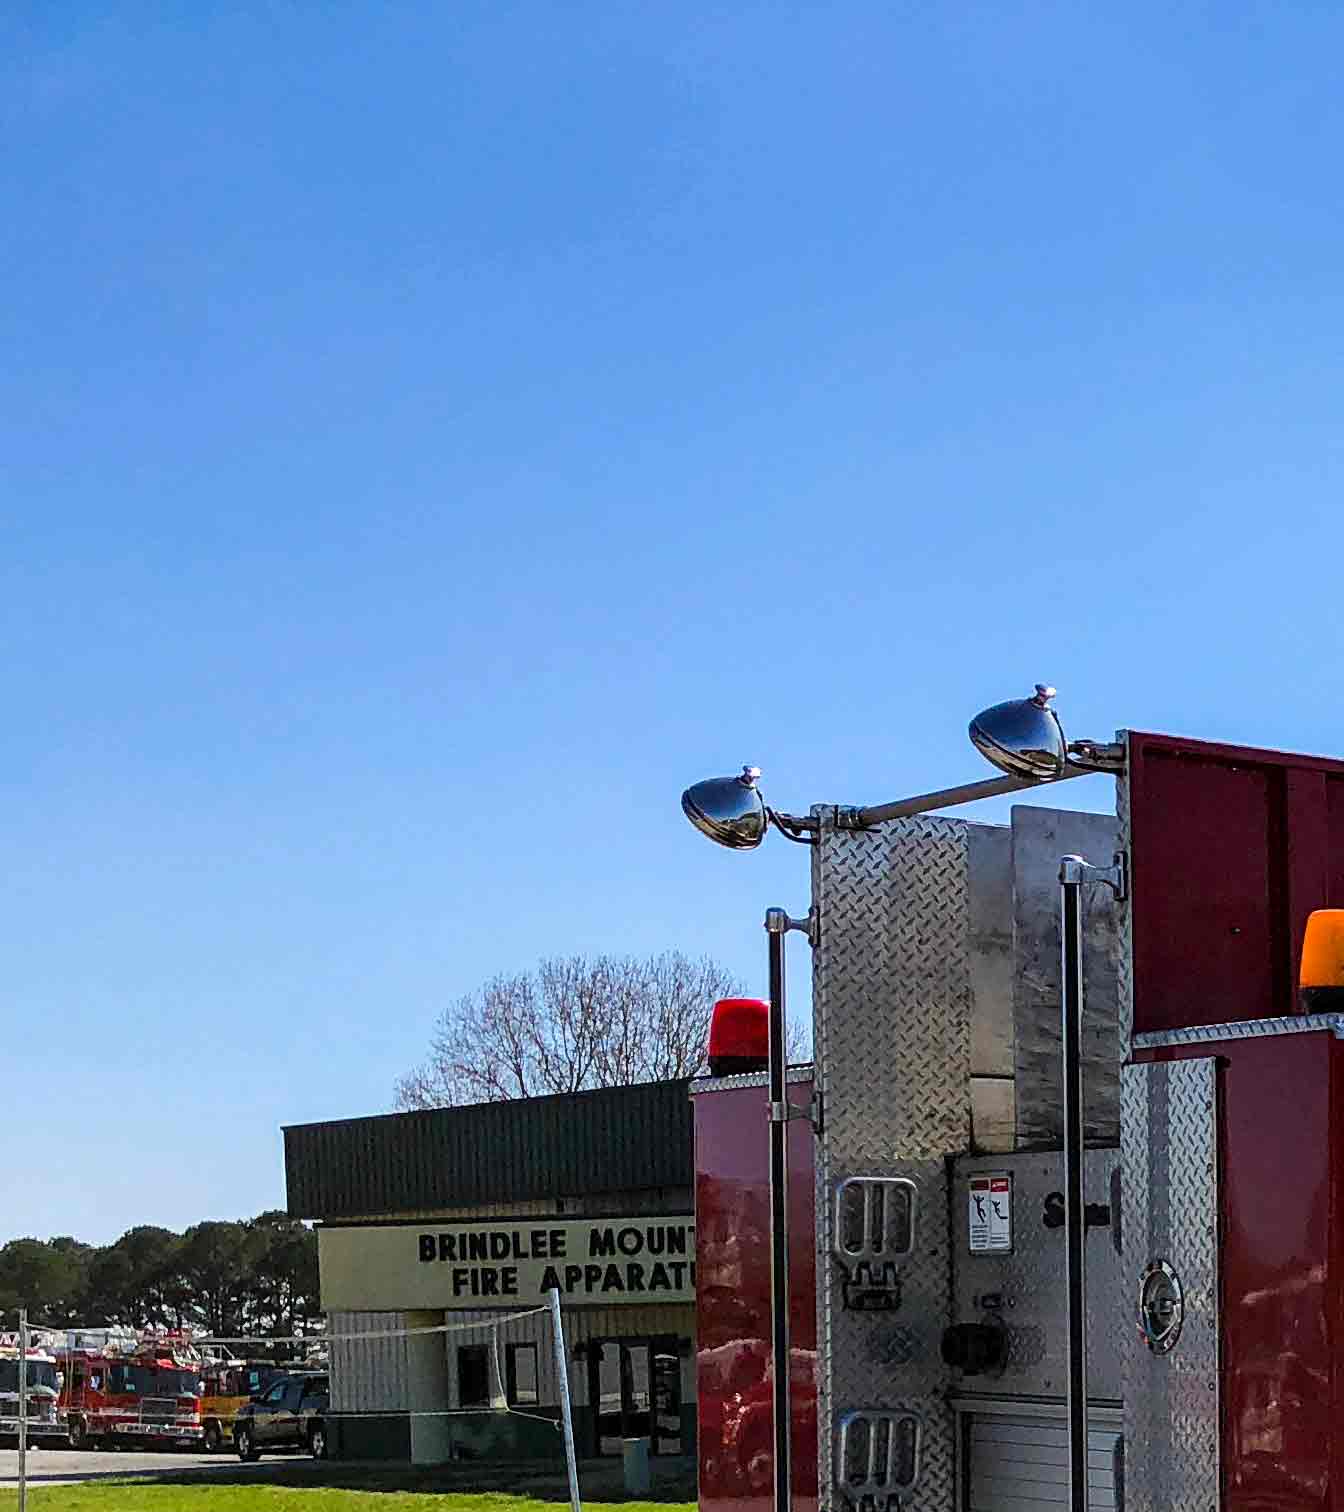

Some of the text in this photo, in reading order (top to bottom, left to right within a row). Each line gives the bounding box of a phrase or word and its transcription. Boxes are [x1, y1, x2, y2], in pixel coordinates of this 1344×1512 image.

[418, 1226, 695, 1261] BRINDLEE MOUN
[452, 1266, 519, 1296] FIRE
